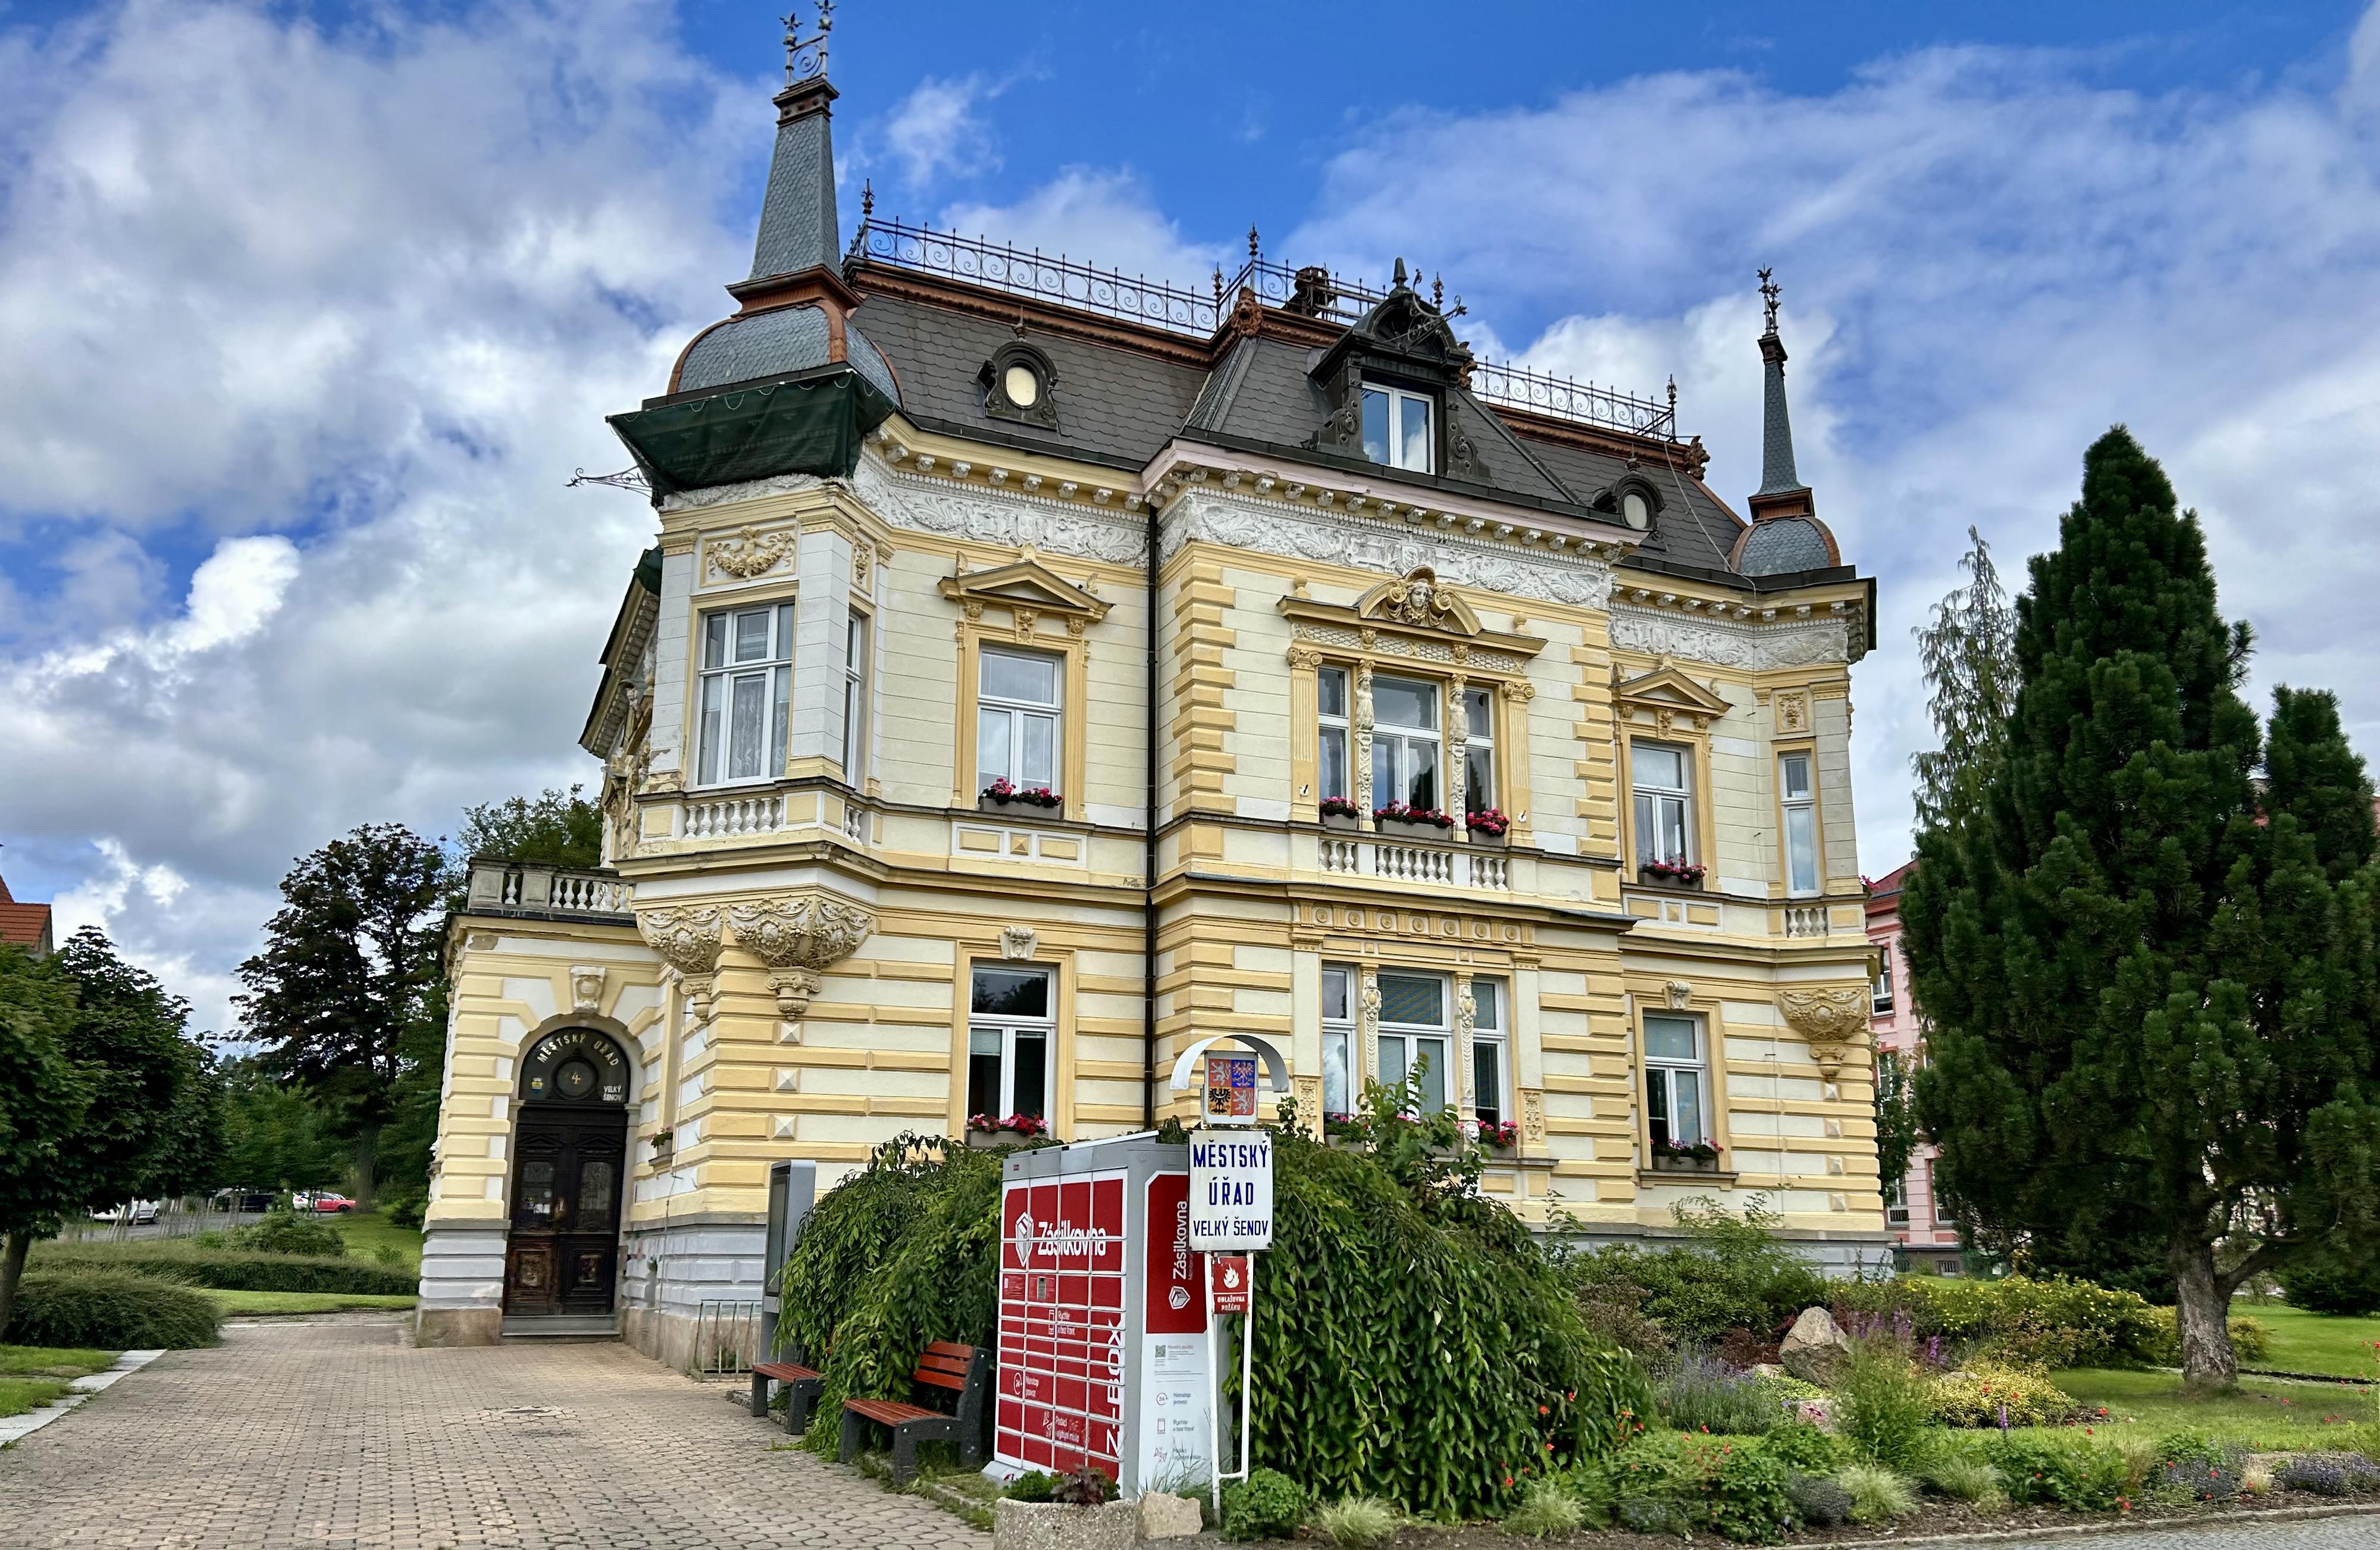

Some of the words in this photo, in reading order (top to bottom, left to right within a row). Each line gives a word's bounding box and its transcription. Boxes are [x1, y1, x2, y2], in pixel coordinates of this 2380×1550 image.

[537, 1033, 586, 1063] MĚSTSKÝ
[571, 1072, 581, 1085] 4
[604, 1085, 622, 1093] VELKÝ
[603, 1093, 622, 1101] ŠENOV
[1193, 1139, 1268, 1168] MĚSTSKÝ
[1209, 1176, 1254, 1205] ÚŘAD
[1038, 1220, 1106, 1256] Zásilkovna
[1173, 1201, 1188, 1280] Zásilkovna
[1194, 1216, 1229, 1236] VELKÝ
[1233, 1216, 1269, 1236] ŠENOV
